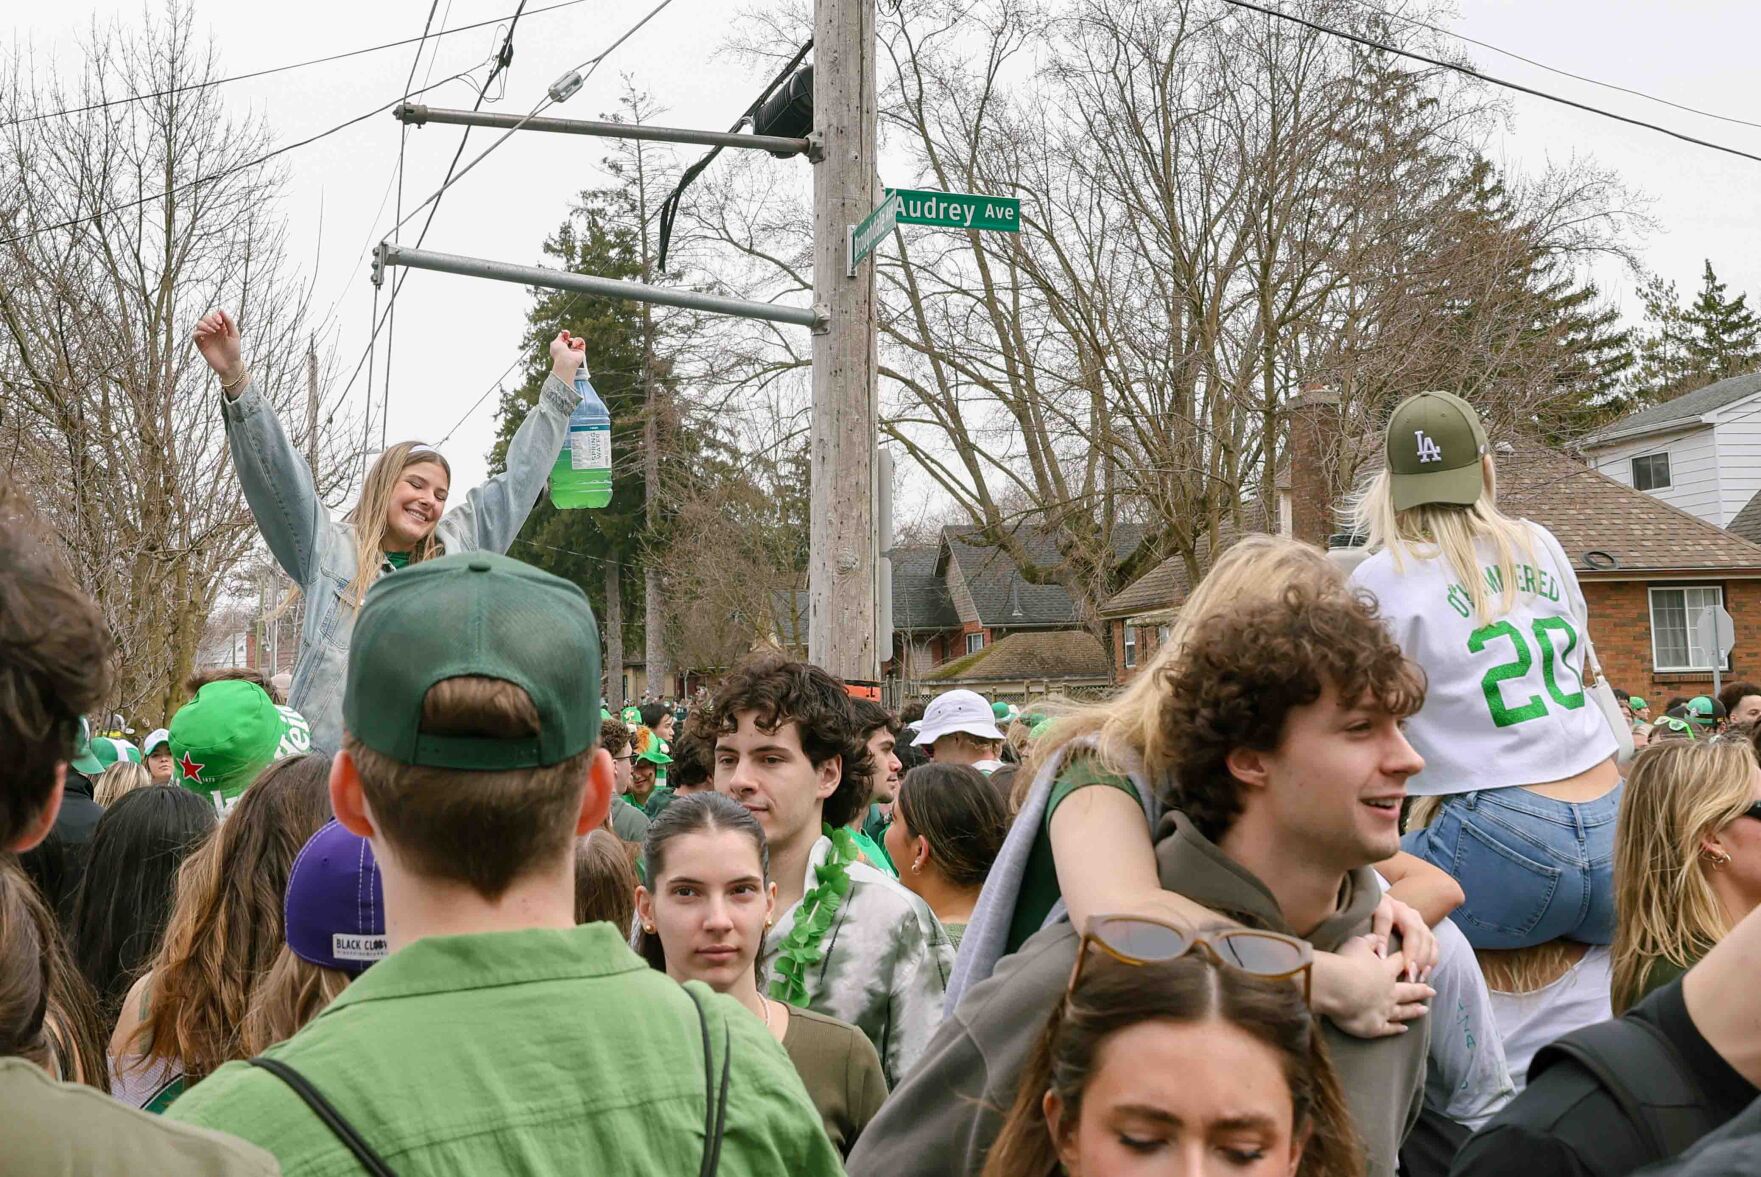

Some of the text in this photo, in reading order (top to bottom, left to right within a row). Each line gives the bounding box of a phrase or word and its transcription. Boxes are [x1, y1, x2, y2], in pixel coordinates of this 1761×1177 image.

[895, 196, 1014, 226] Audrey Ave
[1414, 430, 1442, 463] LA
[1467, 616, 1586, 728] 20
[336, 939, 361, 950] BLACK
